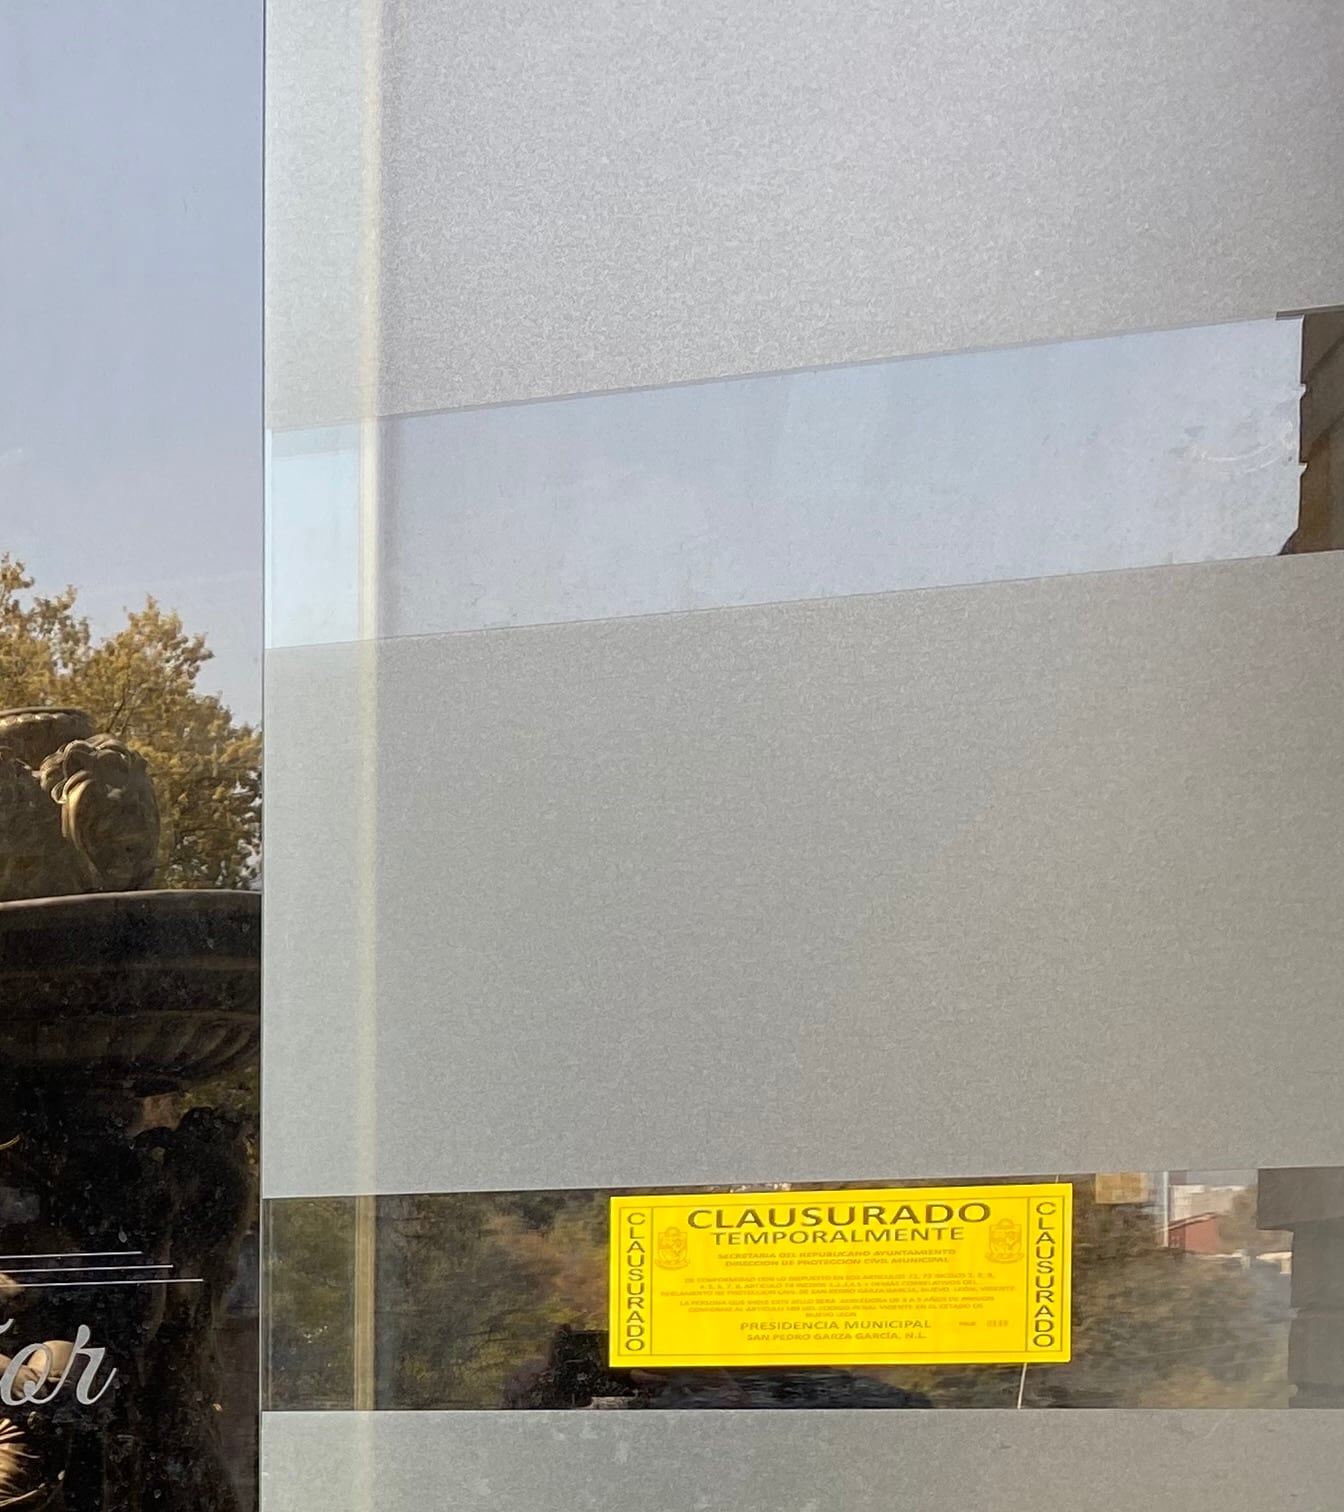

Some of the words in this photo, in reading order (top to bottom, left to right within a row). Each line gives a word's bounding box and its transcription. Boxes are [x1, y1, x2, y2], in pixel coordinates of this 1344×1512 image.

[687, 1202, 992, 1230] CLAUSURADO
[712, 1227, 965, 1246] TEMPORALMENTE
[625, 1211, 647, 1352] CLAUSURADO
[1032, 1201, 1057, 1348] CLAUSURADO
[739, 1320, 840, 1331] PRESIDENCIA
[844, 1319, 932, 1330] MUNICIPAL
